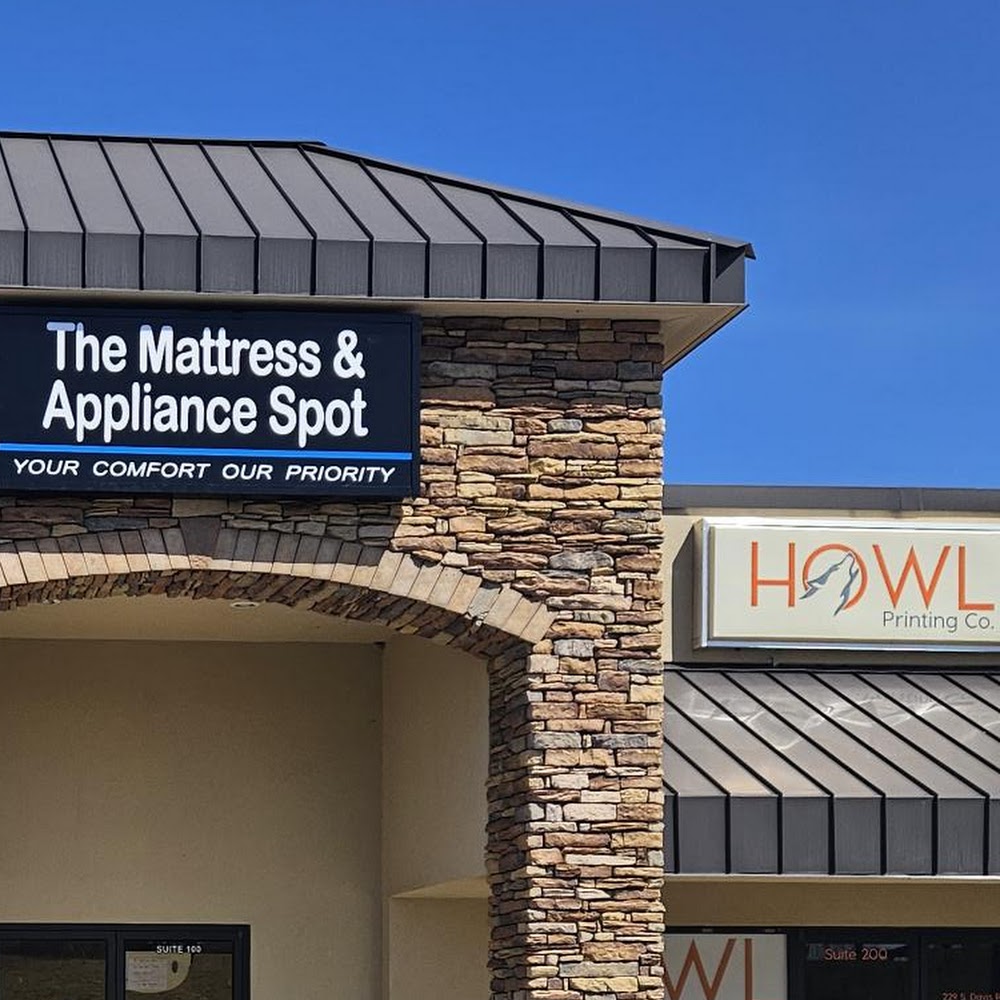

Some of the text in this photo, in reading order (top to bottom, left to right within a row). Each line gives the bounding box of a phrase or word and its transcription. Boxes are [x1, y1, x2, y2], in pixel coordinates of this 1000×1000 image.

[46, 321, 366, 380] The Mattress &
[42, 379, 369, 448] Appliance Spot
[13, 458, 396, 483] YOUR COMFORT OUR PRIORITY
[751, 541, 995, 612] HOWL
[882, 611, 995, 633] Printing Co.
[156, 945, 184, 954] SUITE
[824, 947, 888, 961] Suite 200
